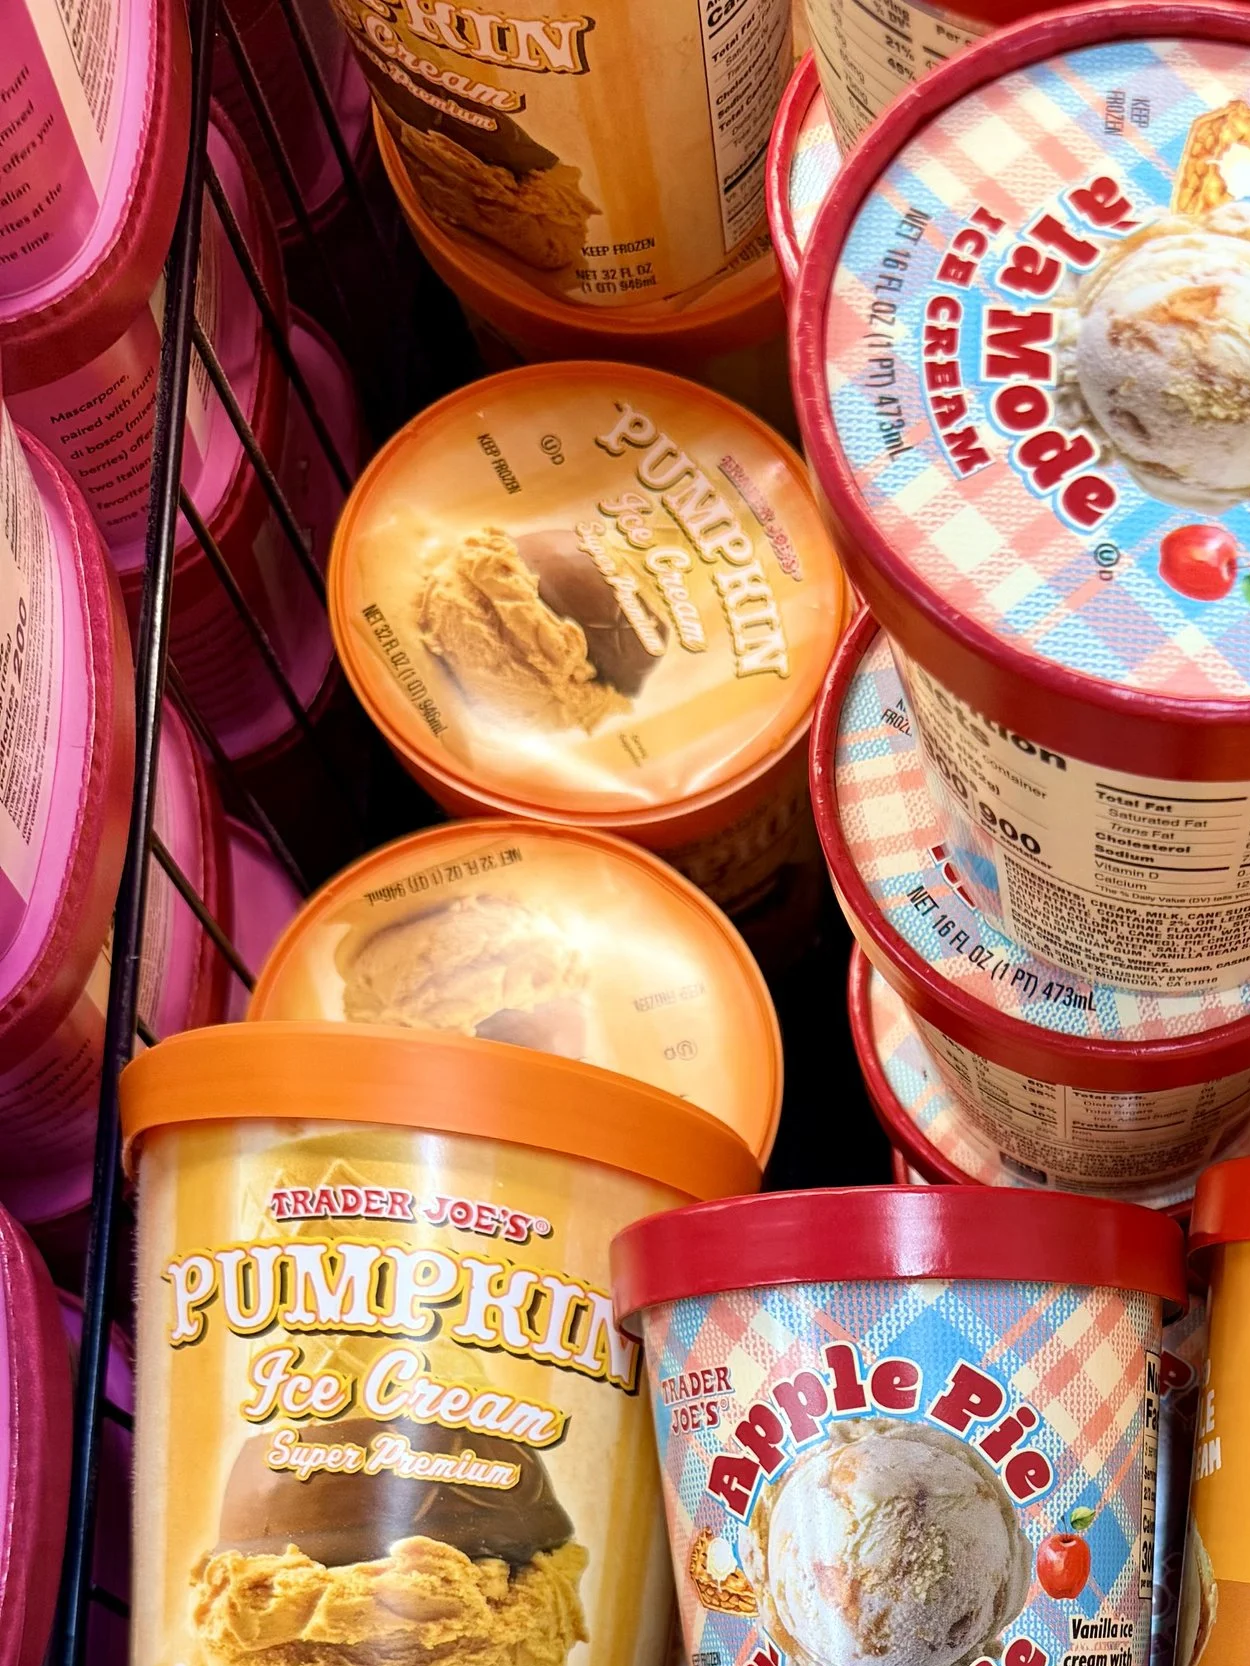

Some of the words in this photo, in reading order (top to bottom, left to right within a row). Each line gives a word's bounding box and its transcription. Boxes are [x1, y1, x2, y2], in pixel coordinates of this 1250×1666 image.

[581, 245, 609, 257] KEEP
[612, 237, 655, 254] FROZEN
[939, 206, 1007, 289] ICE
[999, 216, 1100, 295] la
[50, 374, 130, 425] Mascarpone,
[922, 295, 993, 478] CREAM
[986, 308, 1117, 529] Mode
[596, 402, 790, 679] PUMPKIN
[599, 492, 654, 548] Ice
[644, 547, 706, 653] Cream
[1042, 982, 1097, 1012] 473mL
[271, 1187, 414, 1222] TRADER
[245, 1346, 348, 1418] Ice
[364, 1348, 567, 1446] Cream
[662, 1367, 732, 1405] TRADER
[266, 1430, 363, 1482] Super
[369, 1435, 519, 1488] Premium
[707, 1343, 922, 1517] Apple
[927, 1363, 1056, 1501] Pie
[1071, 1618, 1117, 1640] Vanilla
[1119, 1618, 1133, 1638] ice
